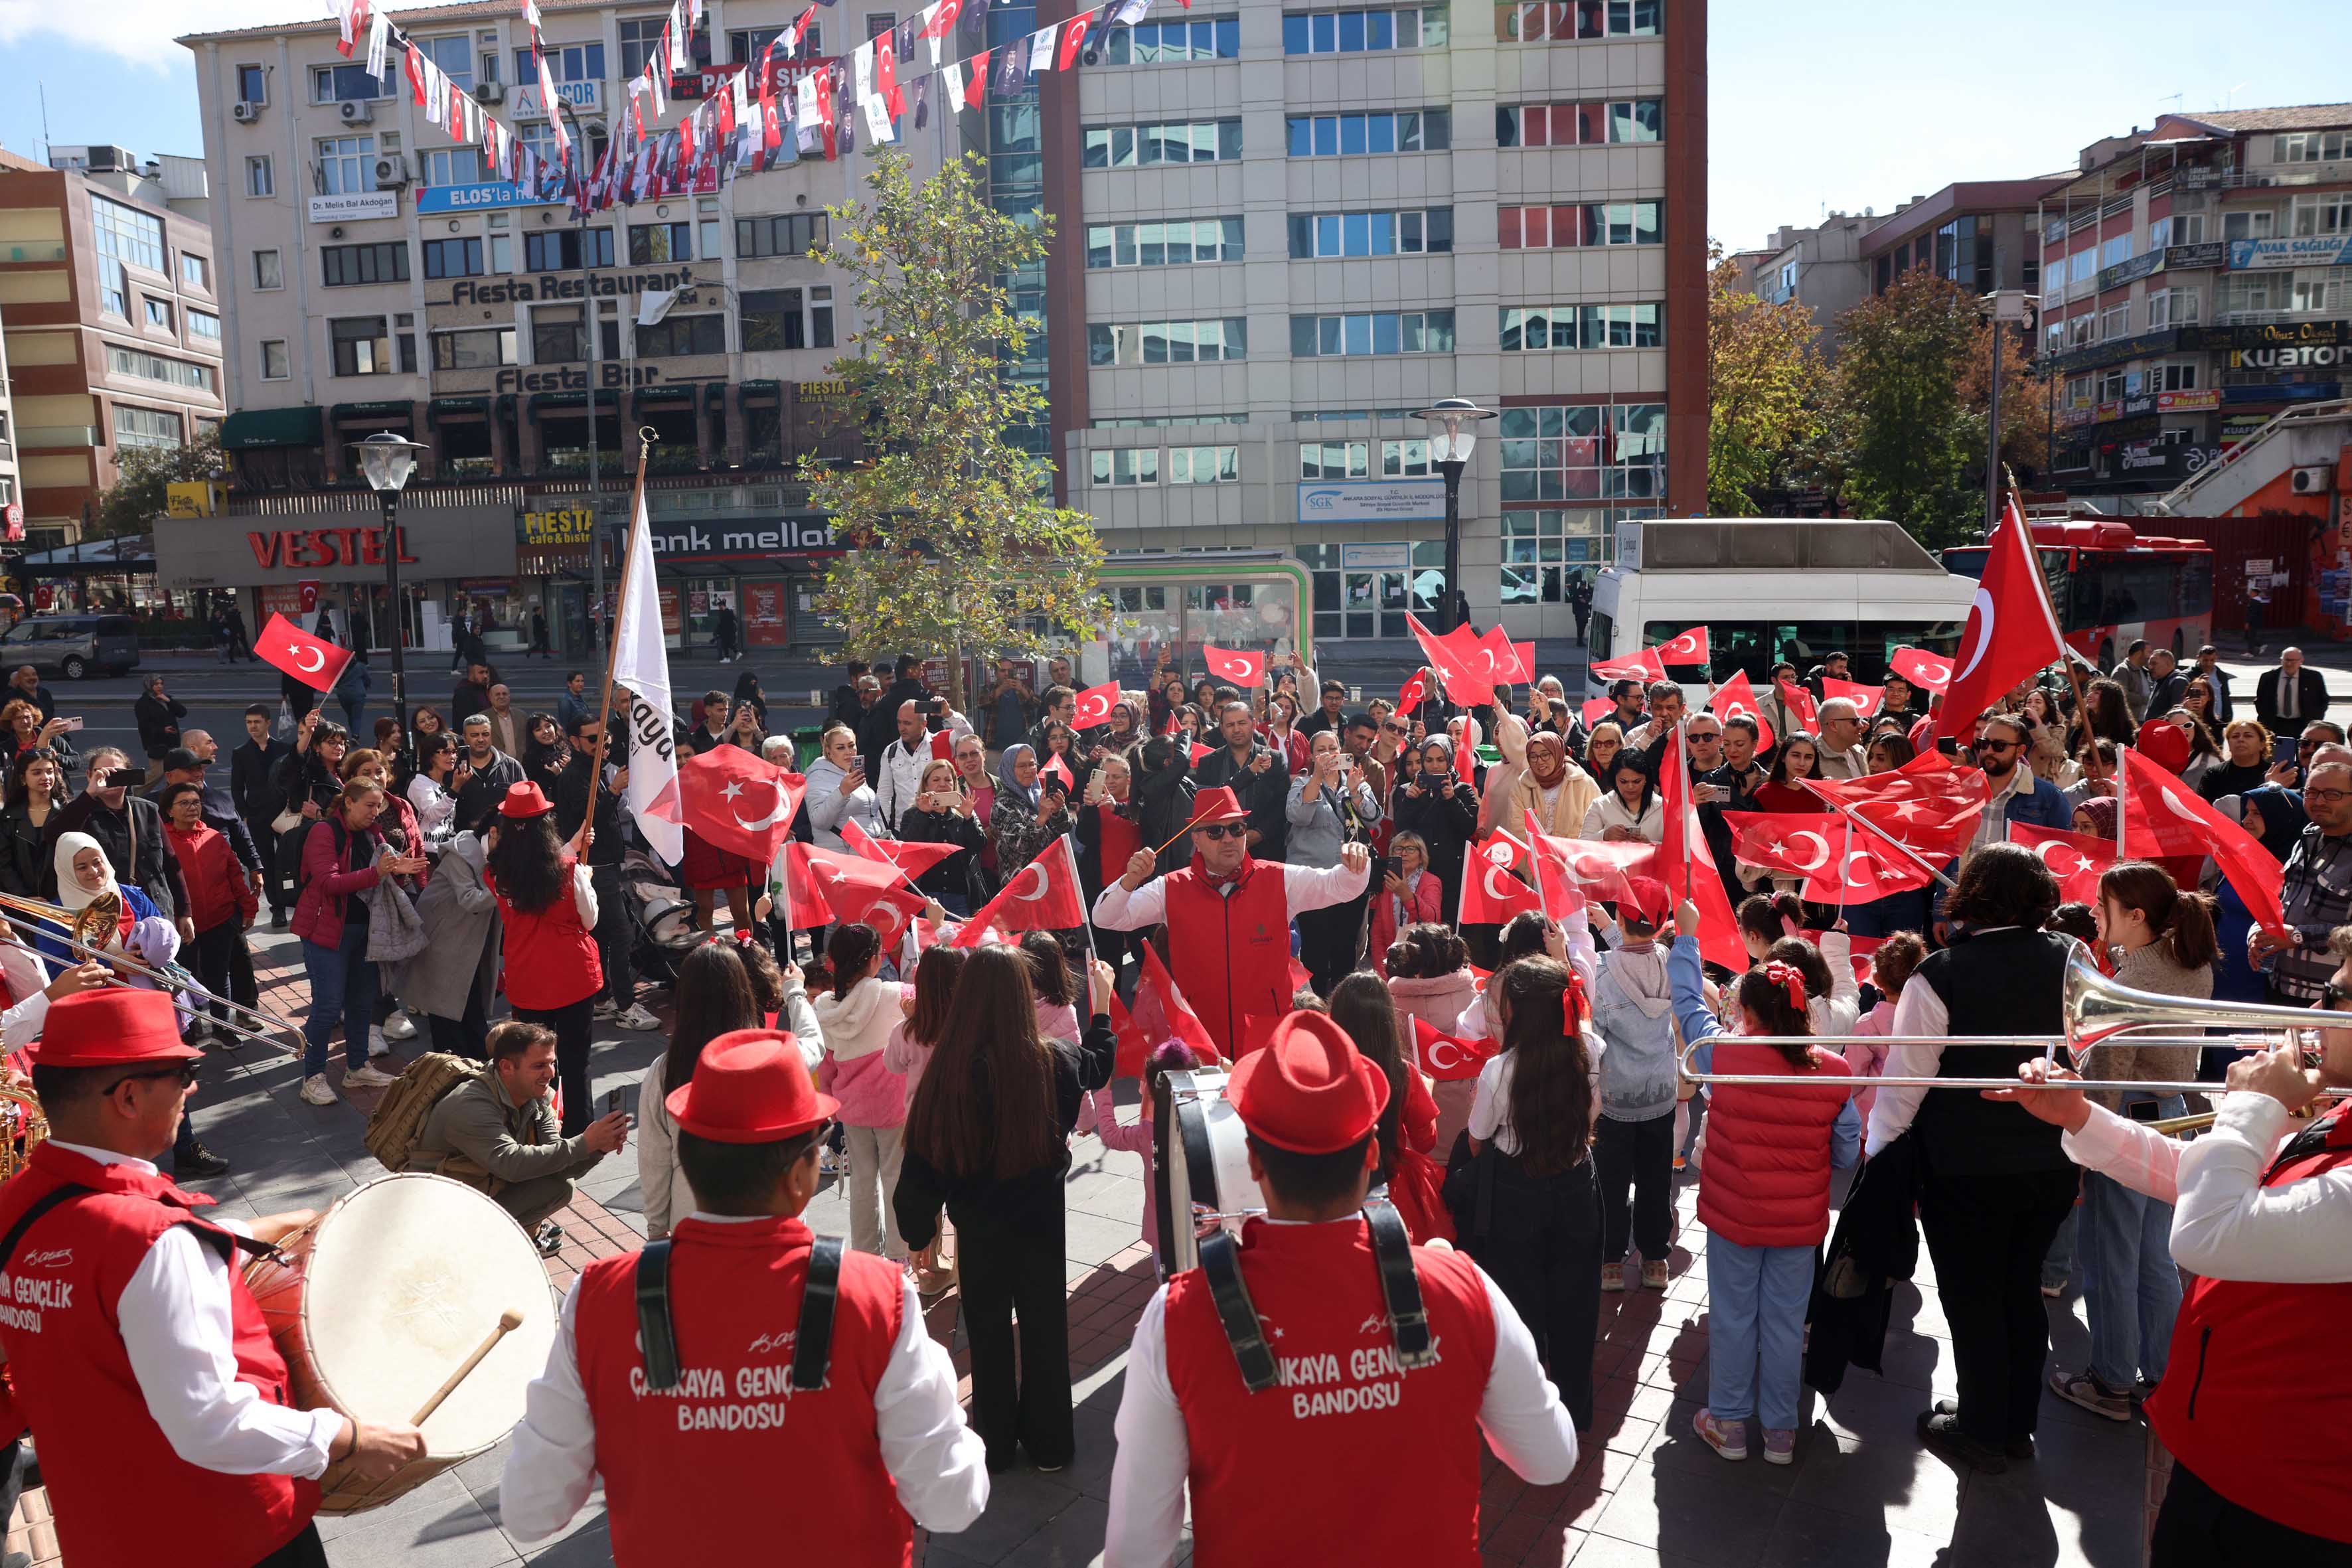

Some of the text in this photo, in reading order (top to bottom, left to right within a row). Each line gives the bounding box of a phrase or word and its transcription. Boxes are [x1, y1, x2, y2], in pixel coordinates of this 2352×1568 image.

[360, 197, 393, 206] Akdoğan
[601, 363, 659, 388] Bar
[1310, 497, 1333, 507] SGK
[246, 525, 417, 568] VESTEL
[564, 531, 590, 543] bistr
[15, 1275, 73, 1312] GENÇLİK
[1293, 1381, 1401, 1419] BANDOSU
[678, 1402, 785, 1431] BANDOSU
